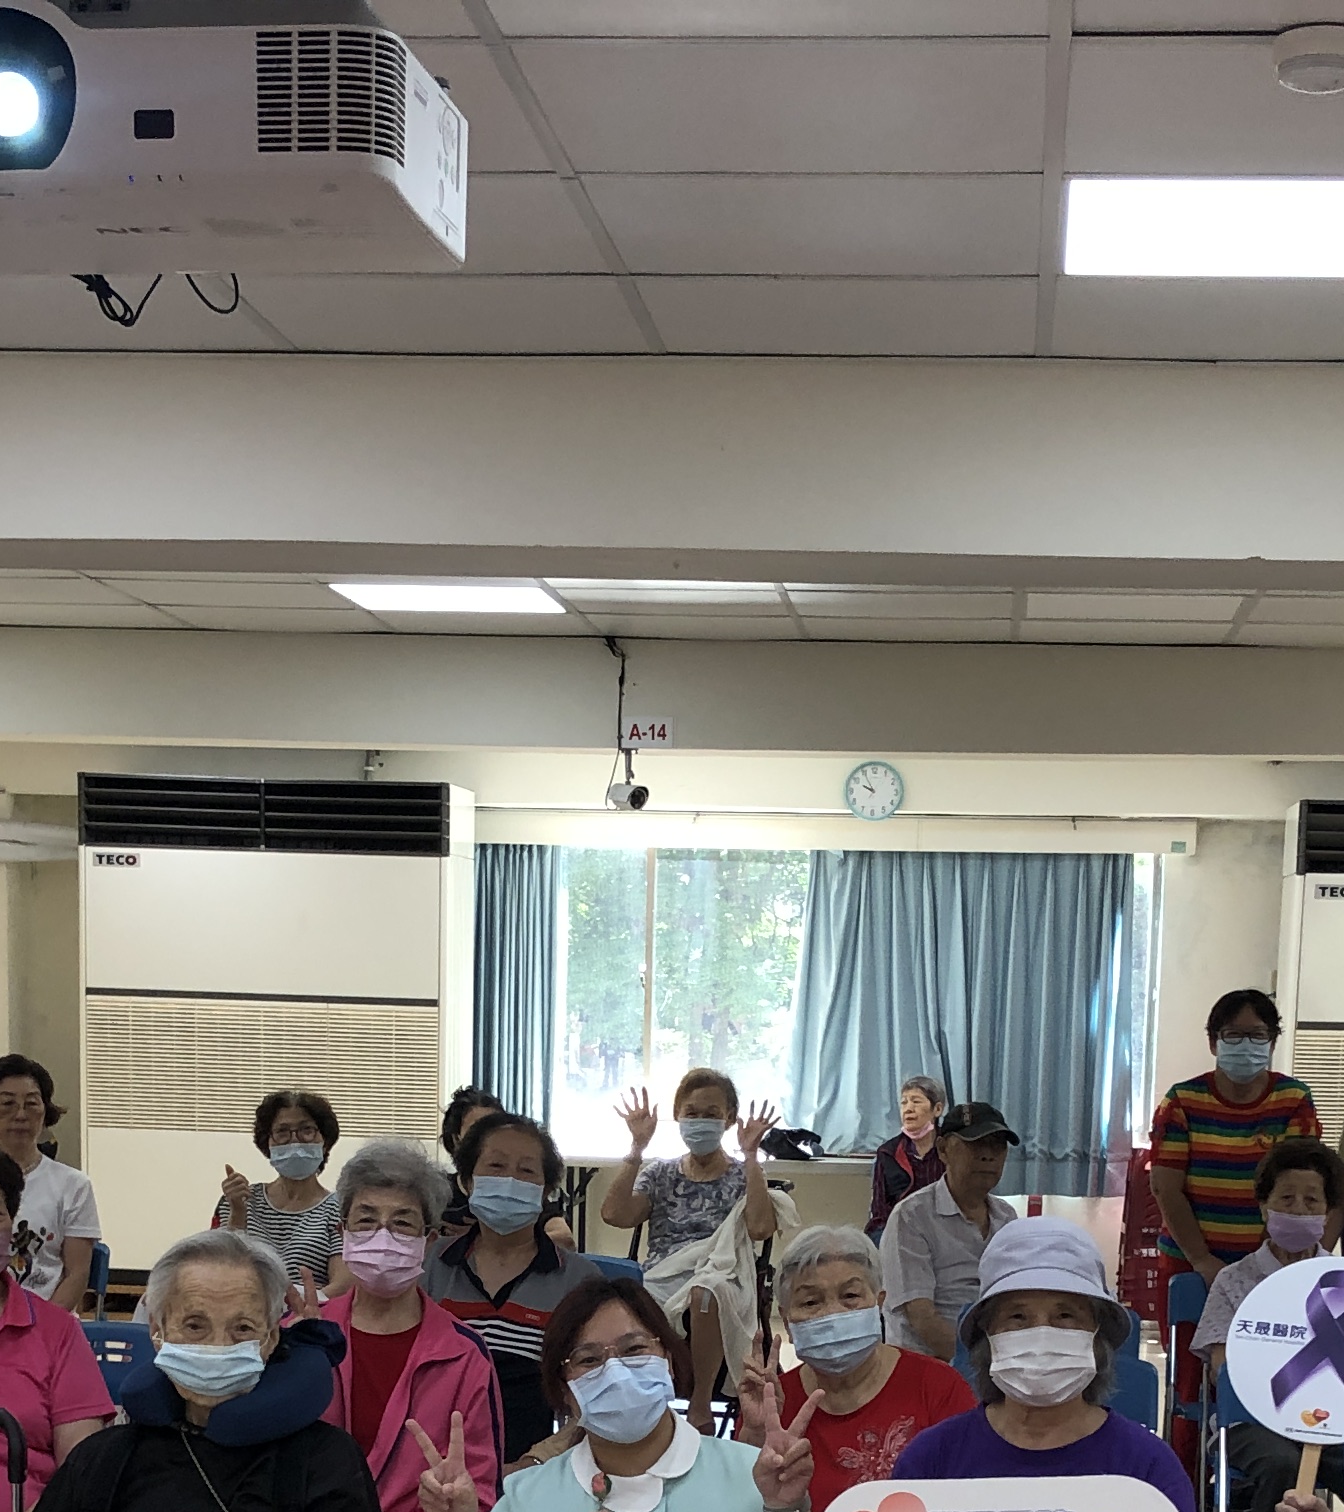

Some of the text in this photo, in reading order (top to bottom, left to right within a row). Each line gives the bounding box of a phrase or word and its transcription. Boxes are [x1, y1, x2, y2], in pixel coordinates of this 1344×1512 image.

[628, 723, 667, 741] A-14
[96, 854, 137, 866] TECO
[1235, 1319, 1308, 1341] 天晟醫院
